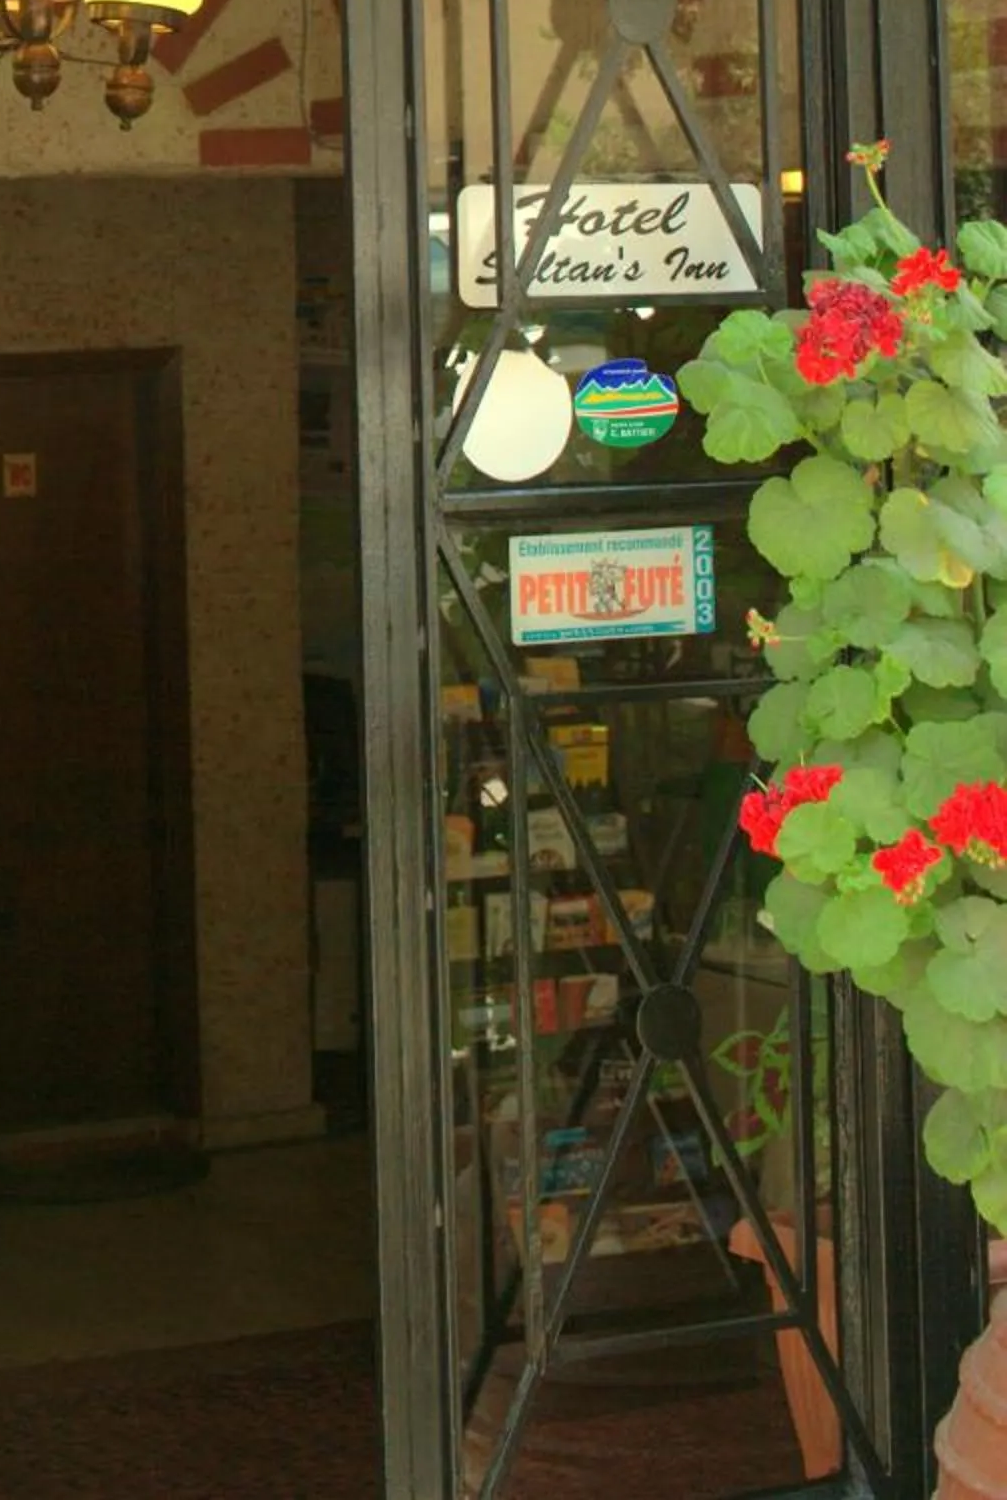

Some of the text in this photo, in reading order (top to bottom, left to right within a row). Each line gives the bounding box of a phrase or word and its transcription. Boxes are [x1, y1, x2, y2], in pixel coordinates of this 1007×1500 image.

[516, 190, 689, 237] Hotel
[475, 246, 730, 285] Sltan's Inn
[519, 554, 685, 615] PETIT FUTÉ
[695, 530, 714, 625] 2003
